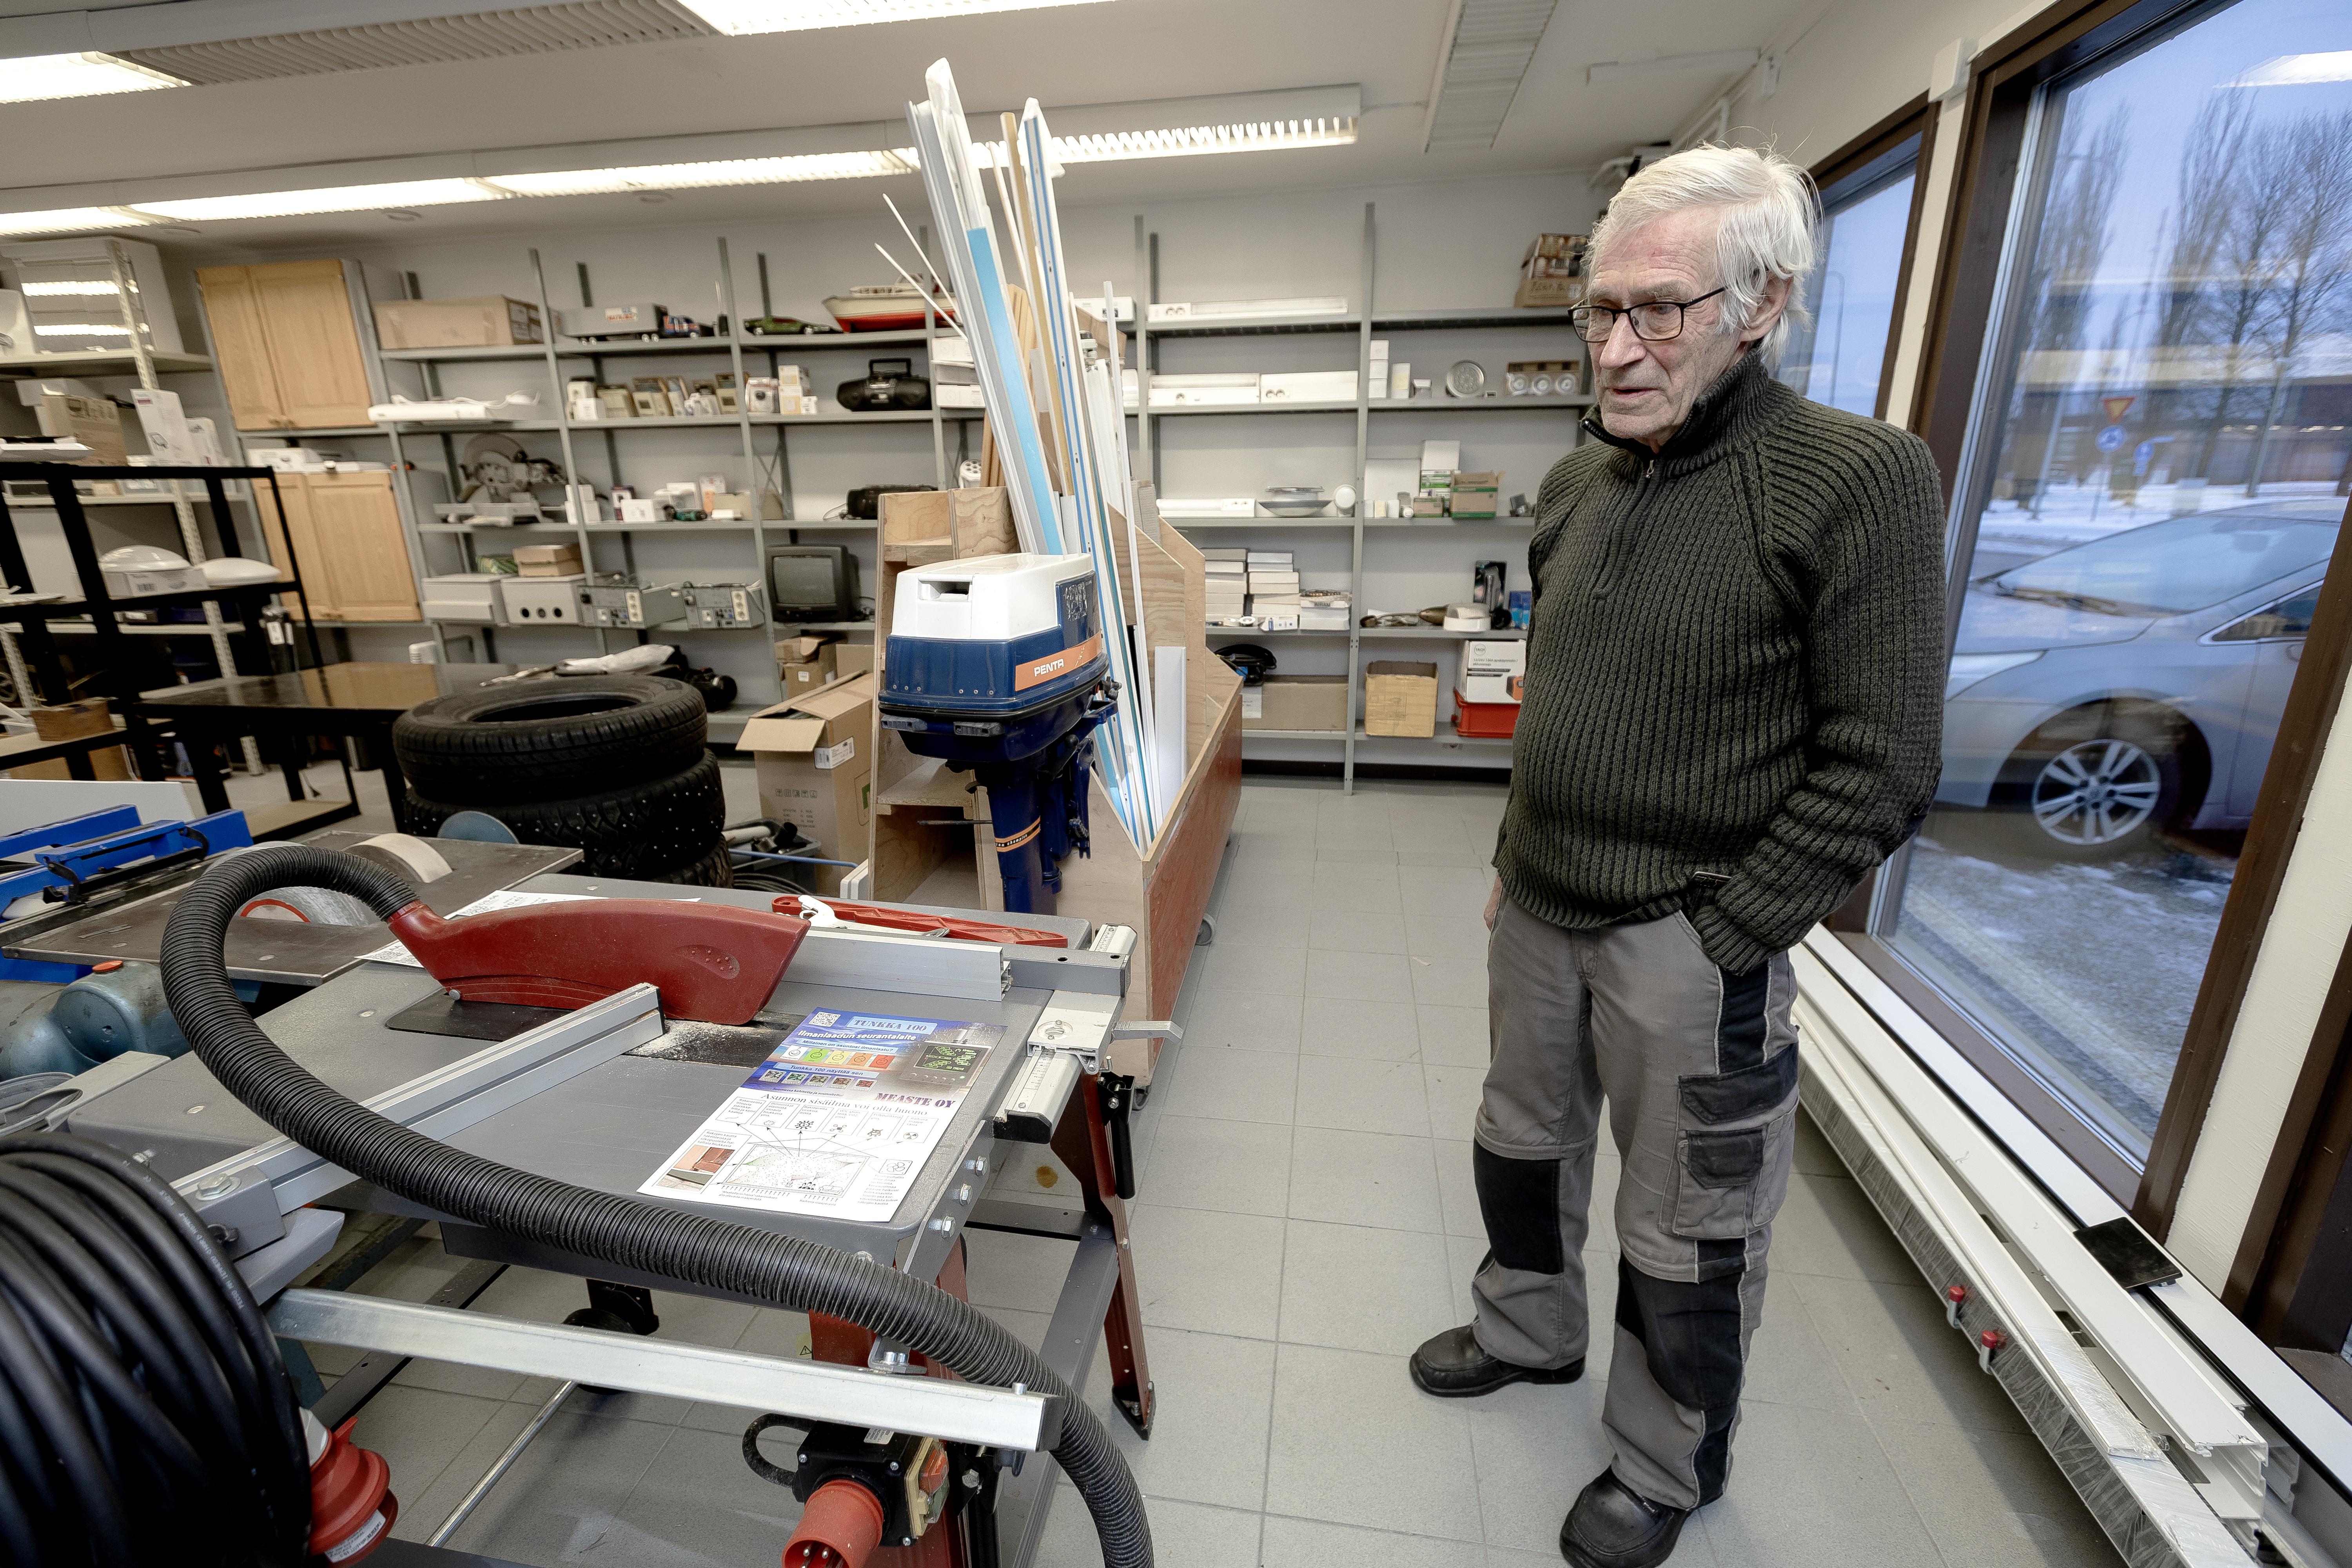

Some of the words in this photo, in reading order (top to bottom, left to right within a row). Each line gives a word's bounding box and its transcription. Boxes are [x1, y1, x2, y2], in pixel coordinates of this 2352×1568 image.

[1034, 658, 1064, 677] PENTA
[1007, 834, 1027, 846] champion
[853, 1020, 902, 1029] TUNKKA
[797, 1030, 856, 1039] Ilmanlaadun
[761, 1094, 806, 1103] Asunnon
[809, 1098, 850, 1108] sisäilma
[895, 1107, 927, 1116] huono
[874, 1093, 933, 1107] MEASTE
[934, 1100, 956, 1109] OY
